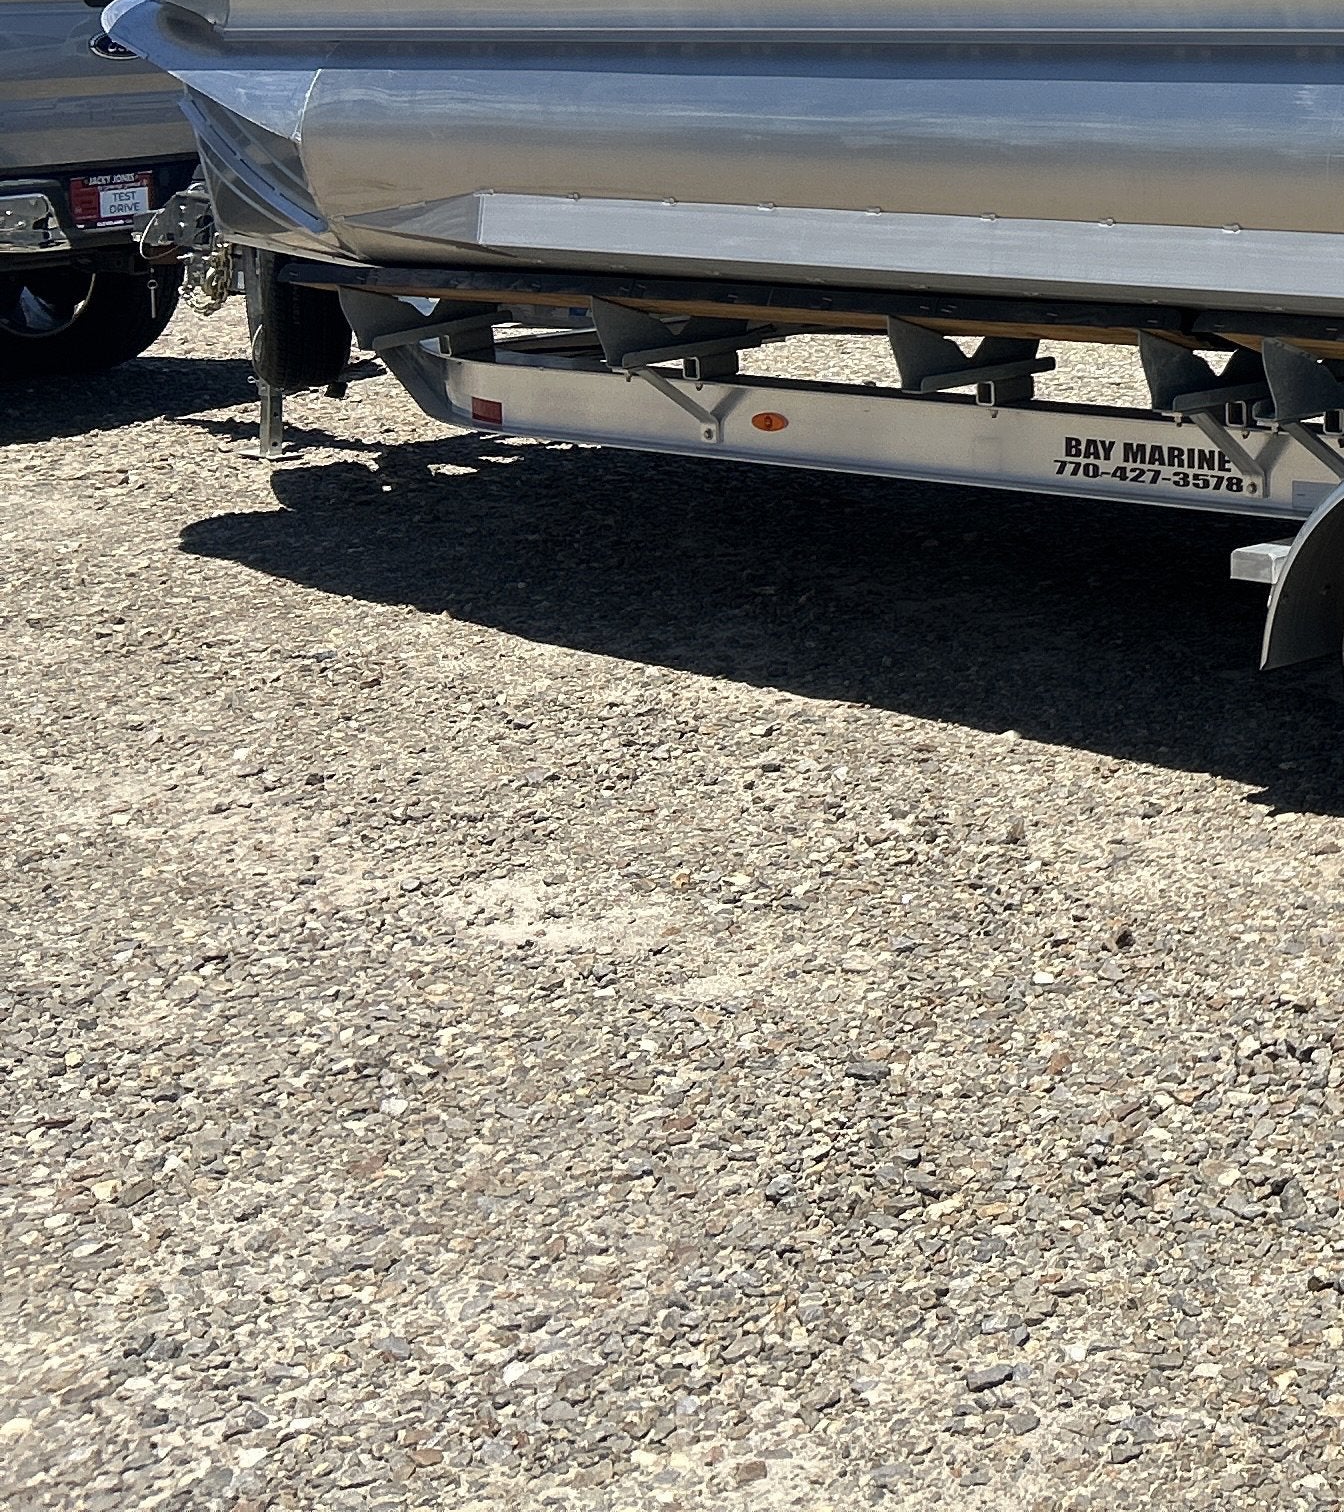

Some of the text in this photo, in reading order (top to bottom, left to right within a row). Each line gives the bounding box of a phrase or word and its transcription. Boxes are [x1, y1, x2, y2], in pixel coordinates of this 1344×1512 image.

[109, 201, 141, 214] DRIVE
[112, 190, 137, 202] TEST
[1064, 436, 1233, 473] BAY MARINE
[1053, 459, 1245, 493] 770-427-3578
